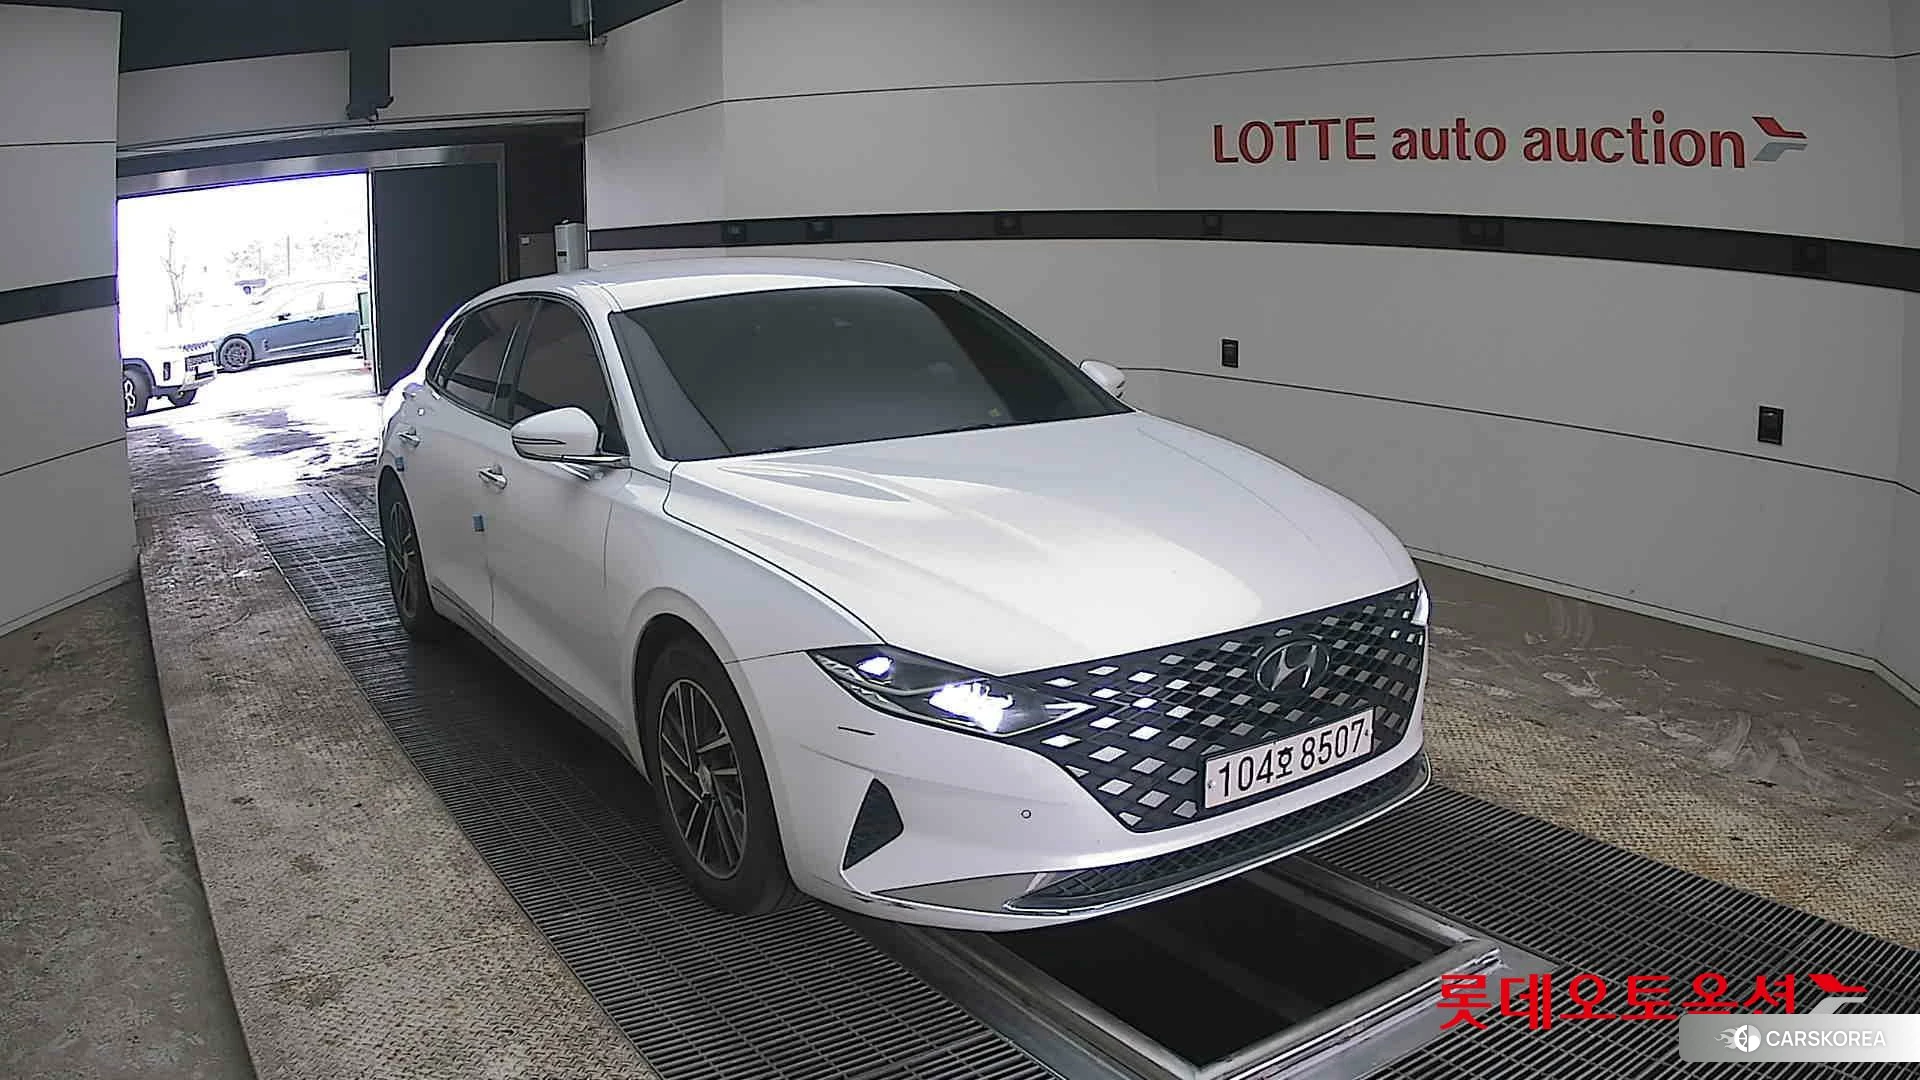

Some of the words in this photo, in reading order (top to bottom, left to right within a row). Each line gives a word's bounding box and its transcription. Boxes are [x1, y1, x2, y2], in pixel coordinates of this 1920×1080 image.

[1214, 117, 1377, 164] LOTTE
[1391, 117, 1507, 161] auto
[1523, 110, 1746, 169] auction
[1219, 746, 1294, 797] 104호
[1301, 718, 1365, 770] 8507
